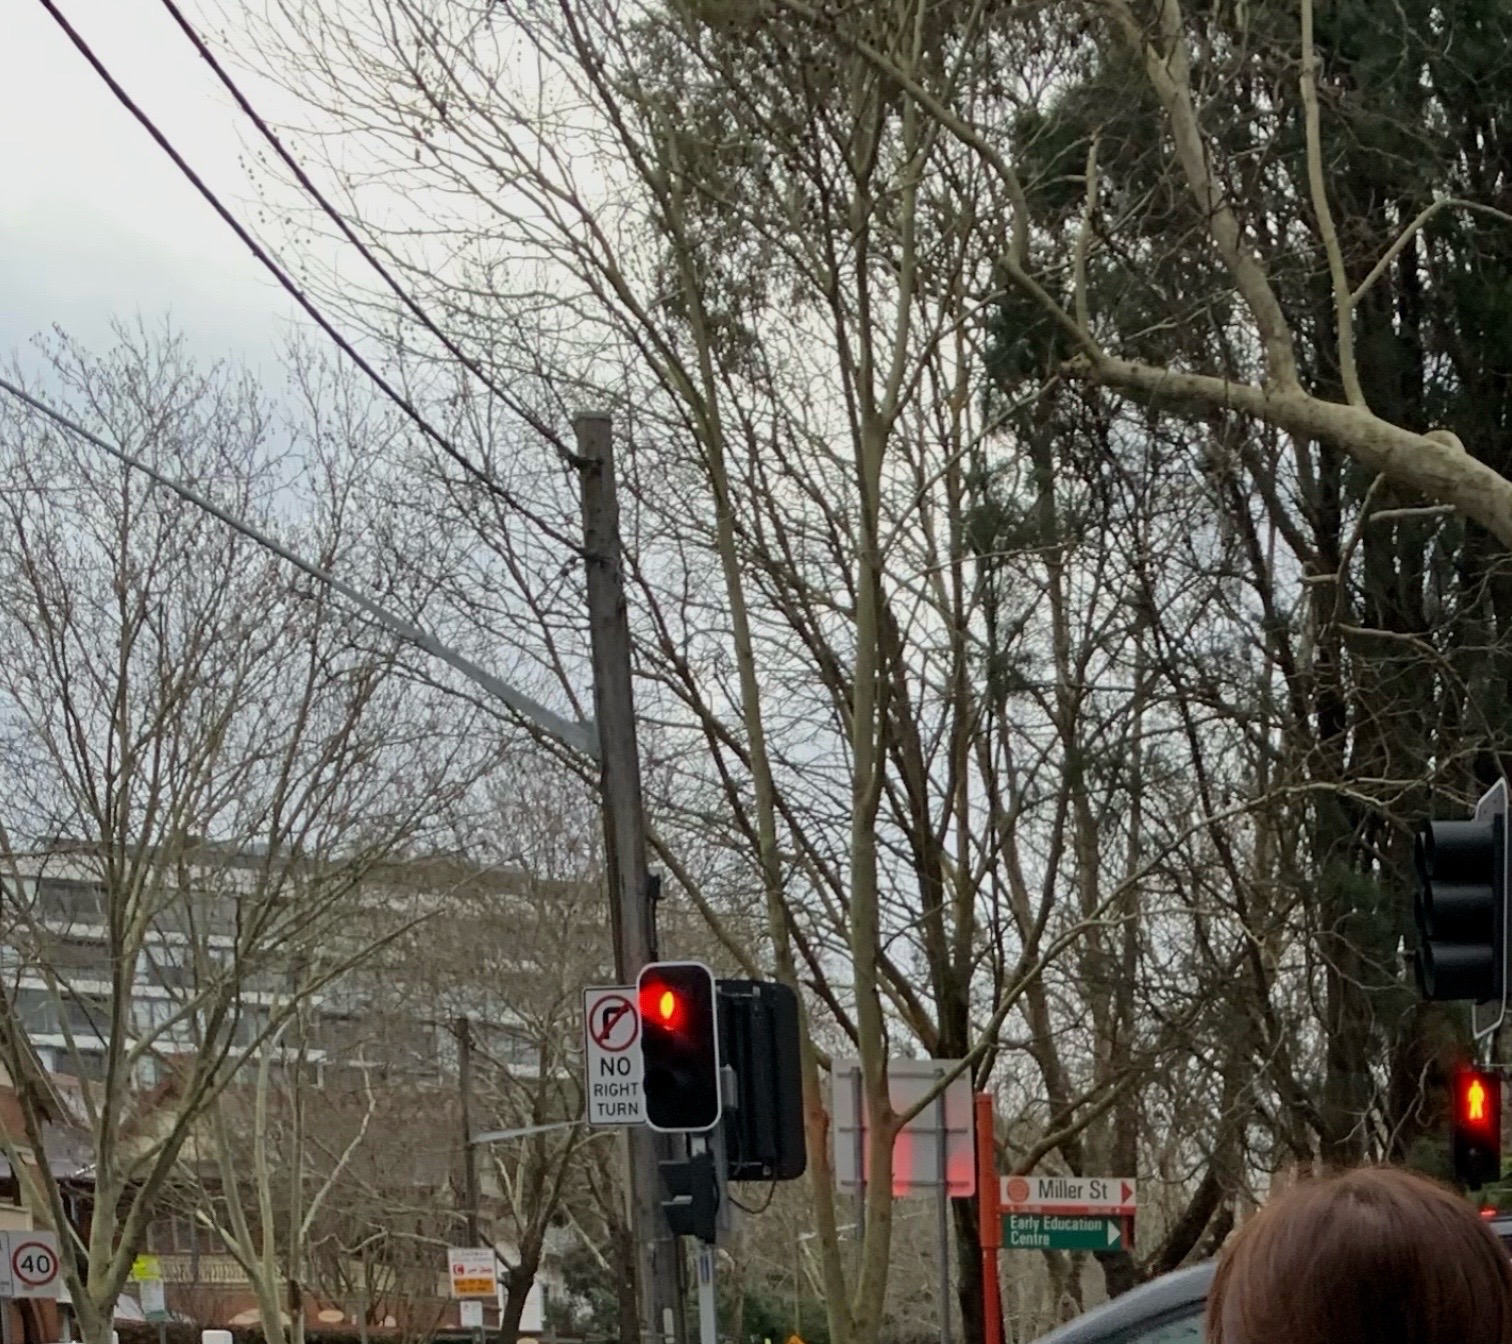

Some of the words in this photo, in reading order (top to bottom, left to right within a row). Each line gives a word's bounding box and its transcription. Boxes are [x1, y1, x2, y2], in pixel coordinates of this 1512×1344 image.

[600, 1056, 631, 1076] NO
[594, 1081, 639, 1097] RIGHT
[597, 1102, 639, 1116] TURN
[1038, 1178, 1084, 1199] Miller
[1089, 1180, 1108, 1200] St
[1010, 1215, 1040, 1232] Early
[1043, 1216, 1102, 1231] Education
[1010, 1231, 1051, 1246] Centre
[21, 1254, 50, 1274] 40
